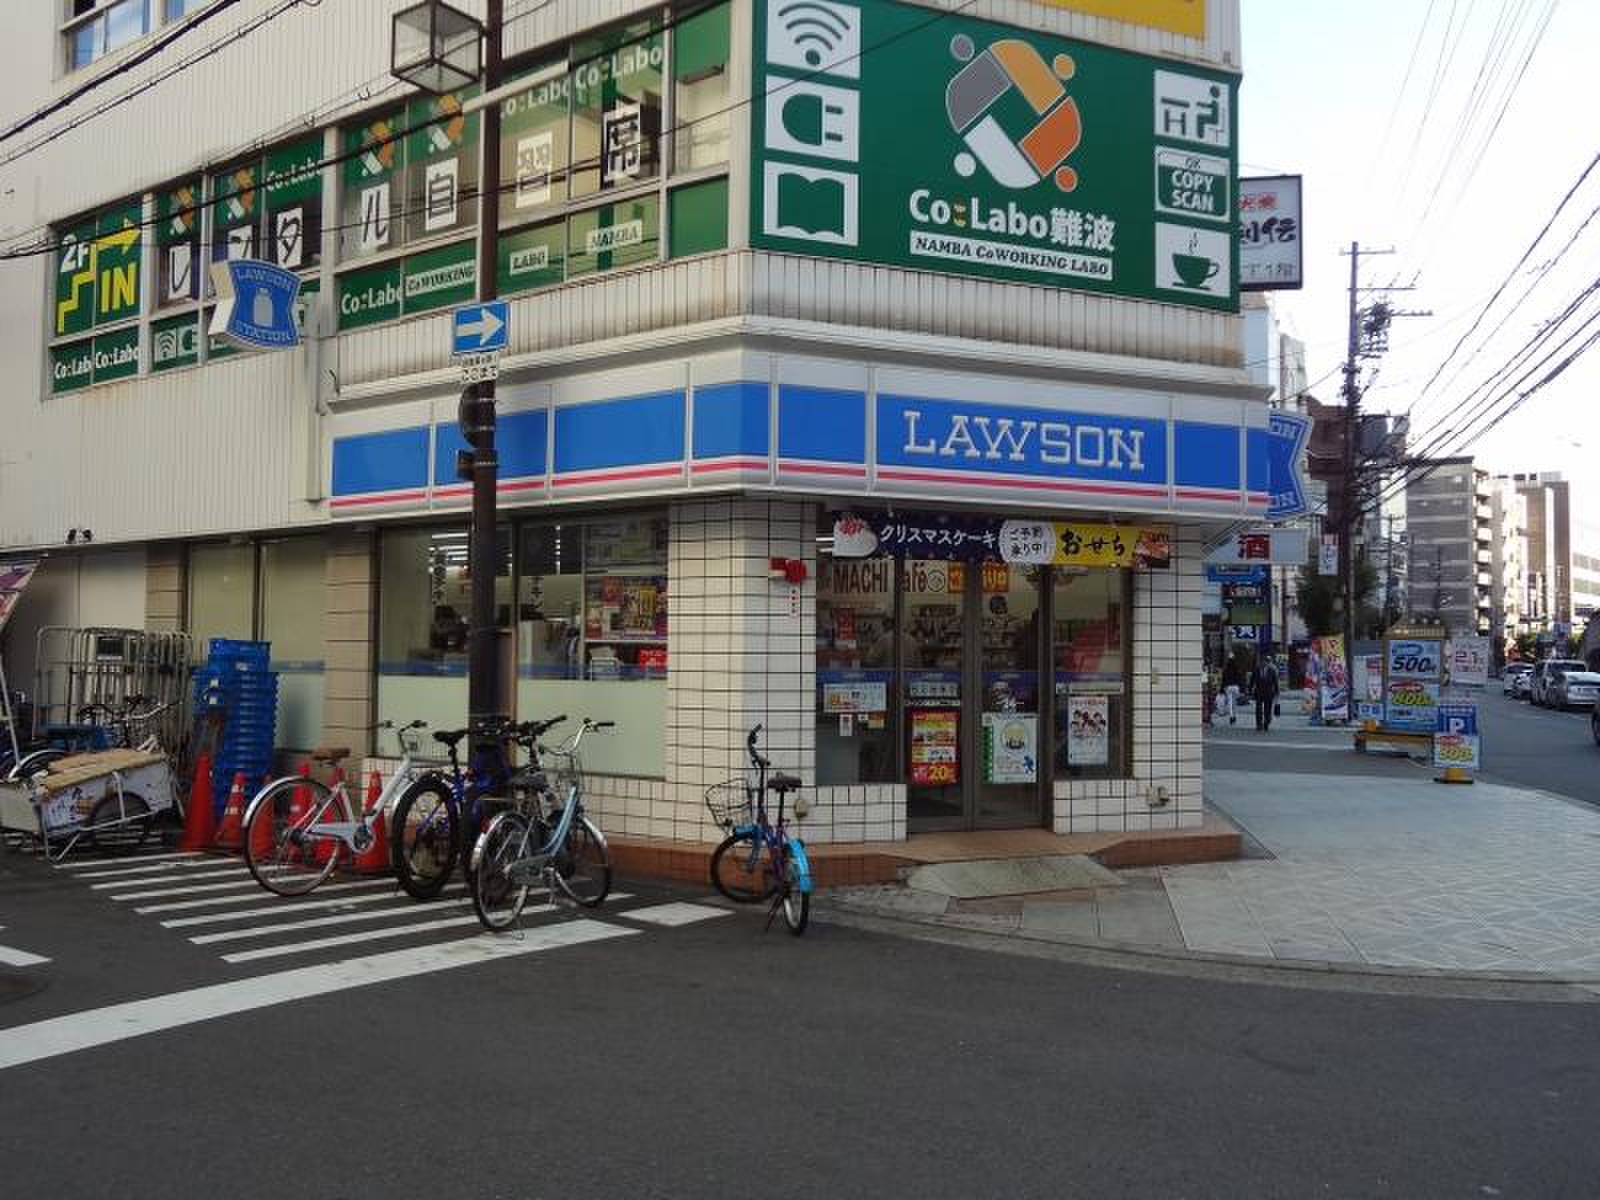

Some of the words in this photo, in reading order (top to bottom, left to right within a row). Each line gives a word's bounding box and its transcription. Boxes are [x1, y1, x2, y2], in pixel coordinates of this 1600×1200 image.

[1172, 172, 1214, 196] COPY
[1172, 190, 1214, 215] SCAN
[61, 234, 90, 272] 2F
[915, 237, 970, 257] NAMBA
[1070, 260, 1107, 275] LABO
[102, 262, 137, 314] IN
[904, 410, 1145, 471] LAWSON
[879, 525, 997, 553] クリスマスケーキ
[832, 560, 890, 593] MACHI
